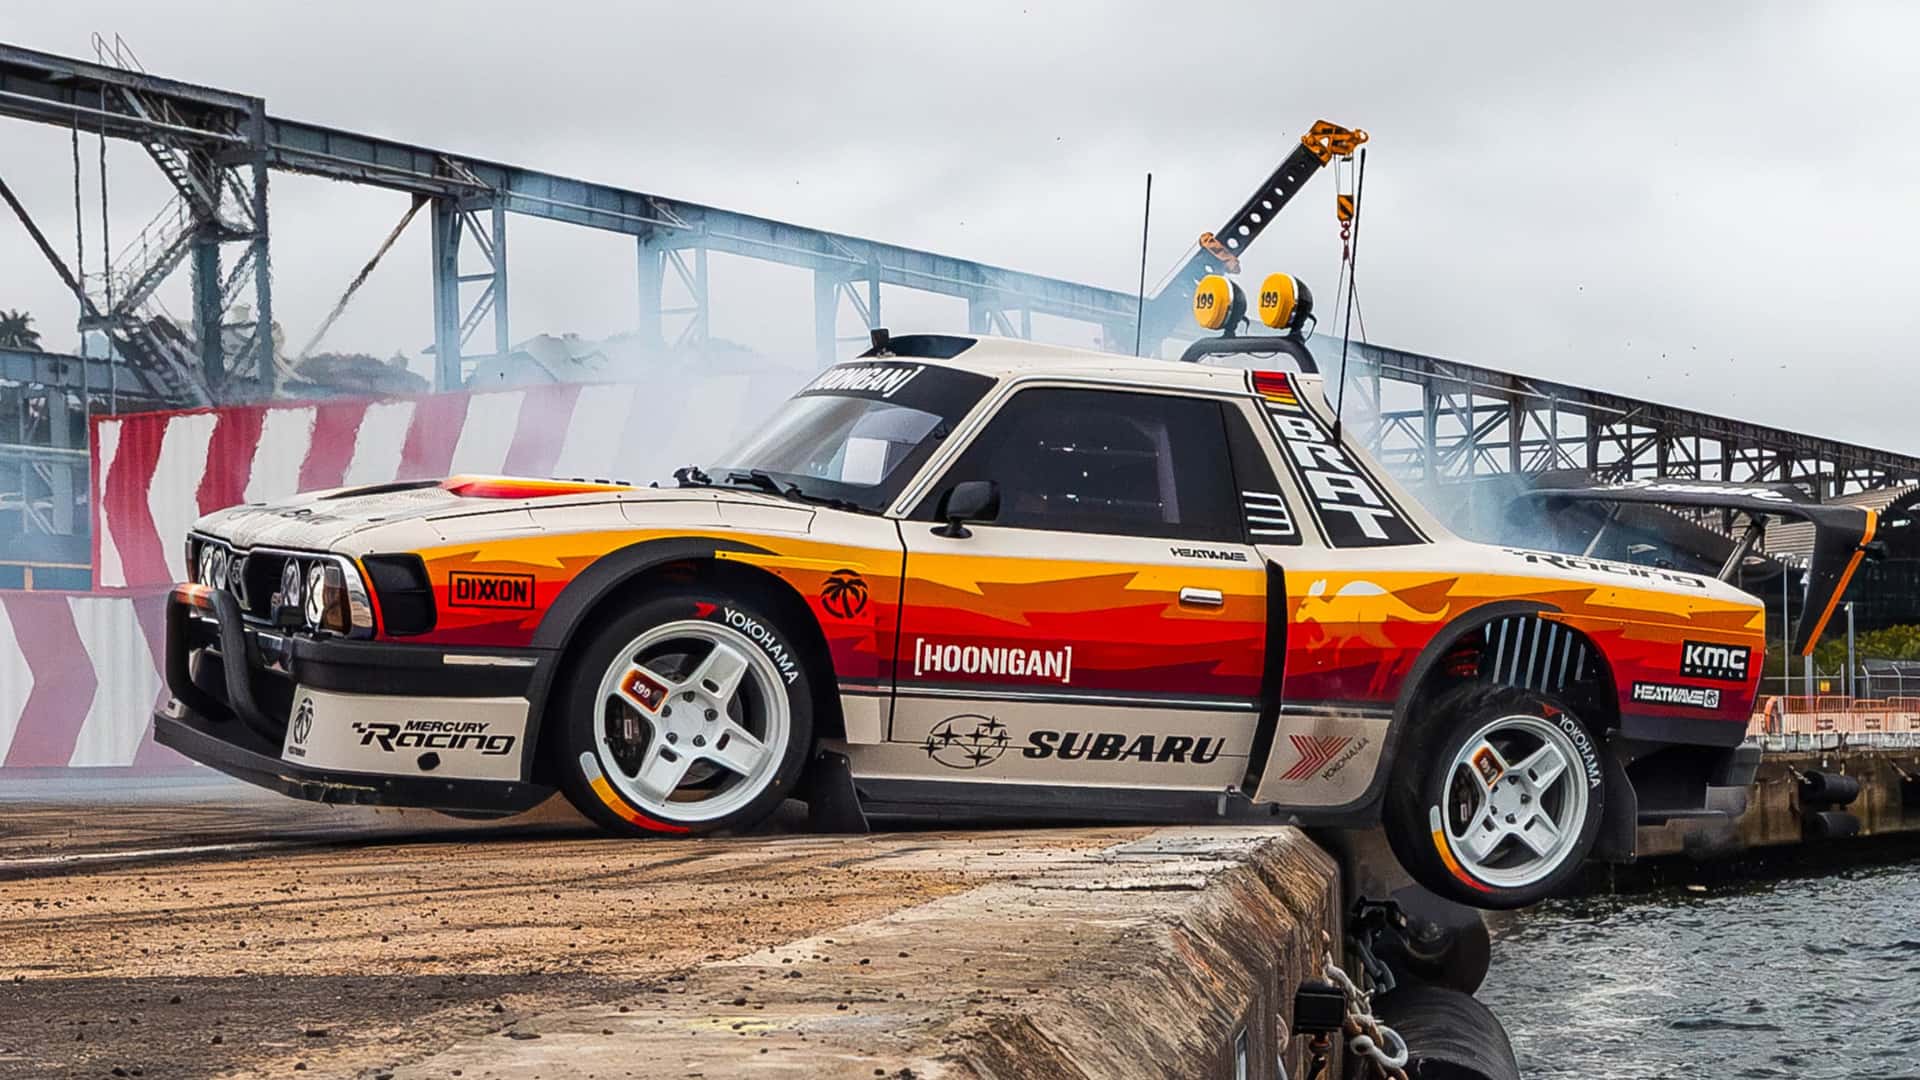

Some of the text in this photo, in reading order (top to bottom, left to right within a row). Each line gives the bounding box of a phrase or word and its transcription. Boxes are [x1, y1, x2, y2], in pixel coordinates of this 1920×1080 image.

[1196, 293, 1214, 309] 199
[1261, 291, 1278, 308] 199
[1272, 414, 1394, 539] BRAT
[1169, 547, 1248, 562] HEATWAVE
[456, 576, 527, 603] DIXXON
[723, 607, 800, 685] YOKOHAMA
[631, 680, 652, 699] 199
[1633, 684, 1705, 705] HEATWAVE
[404, 720, 490, 733] MERCURY
[1022, 729, 1226, 764] SUBARU
[1559, 713, 1601, 789] YOKOHAMA
